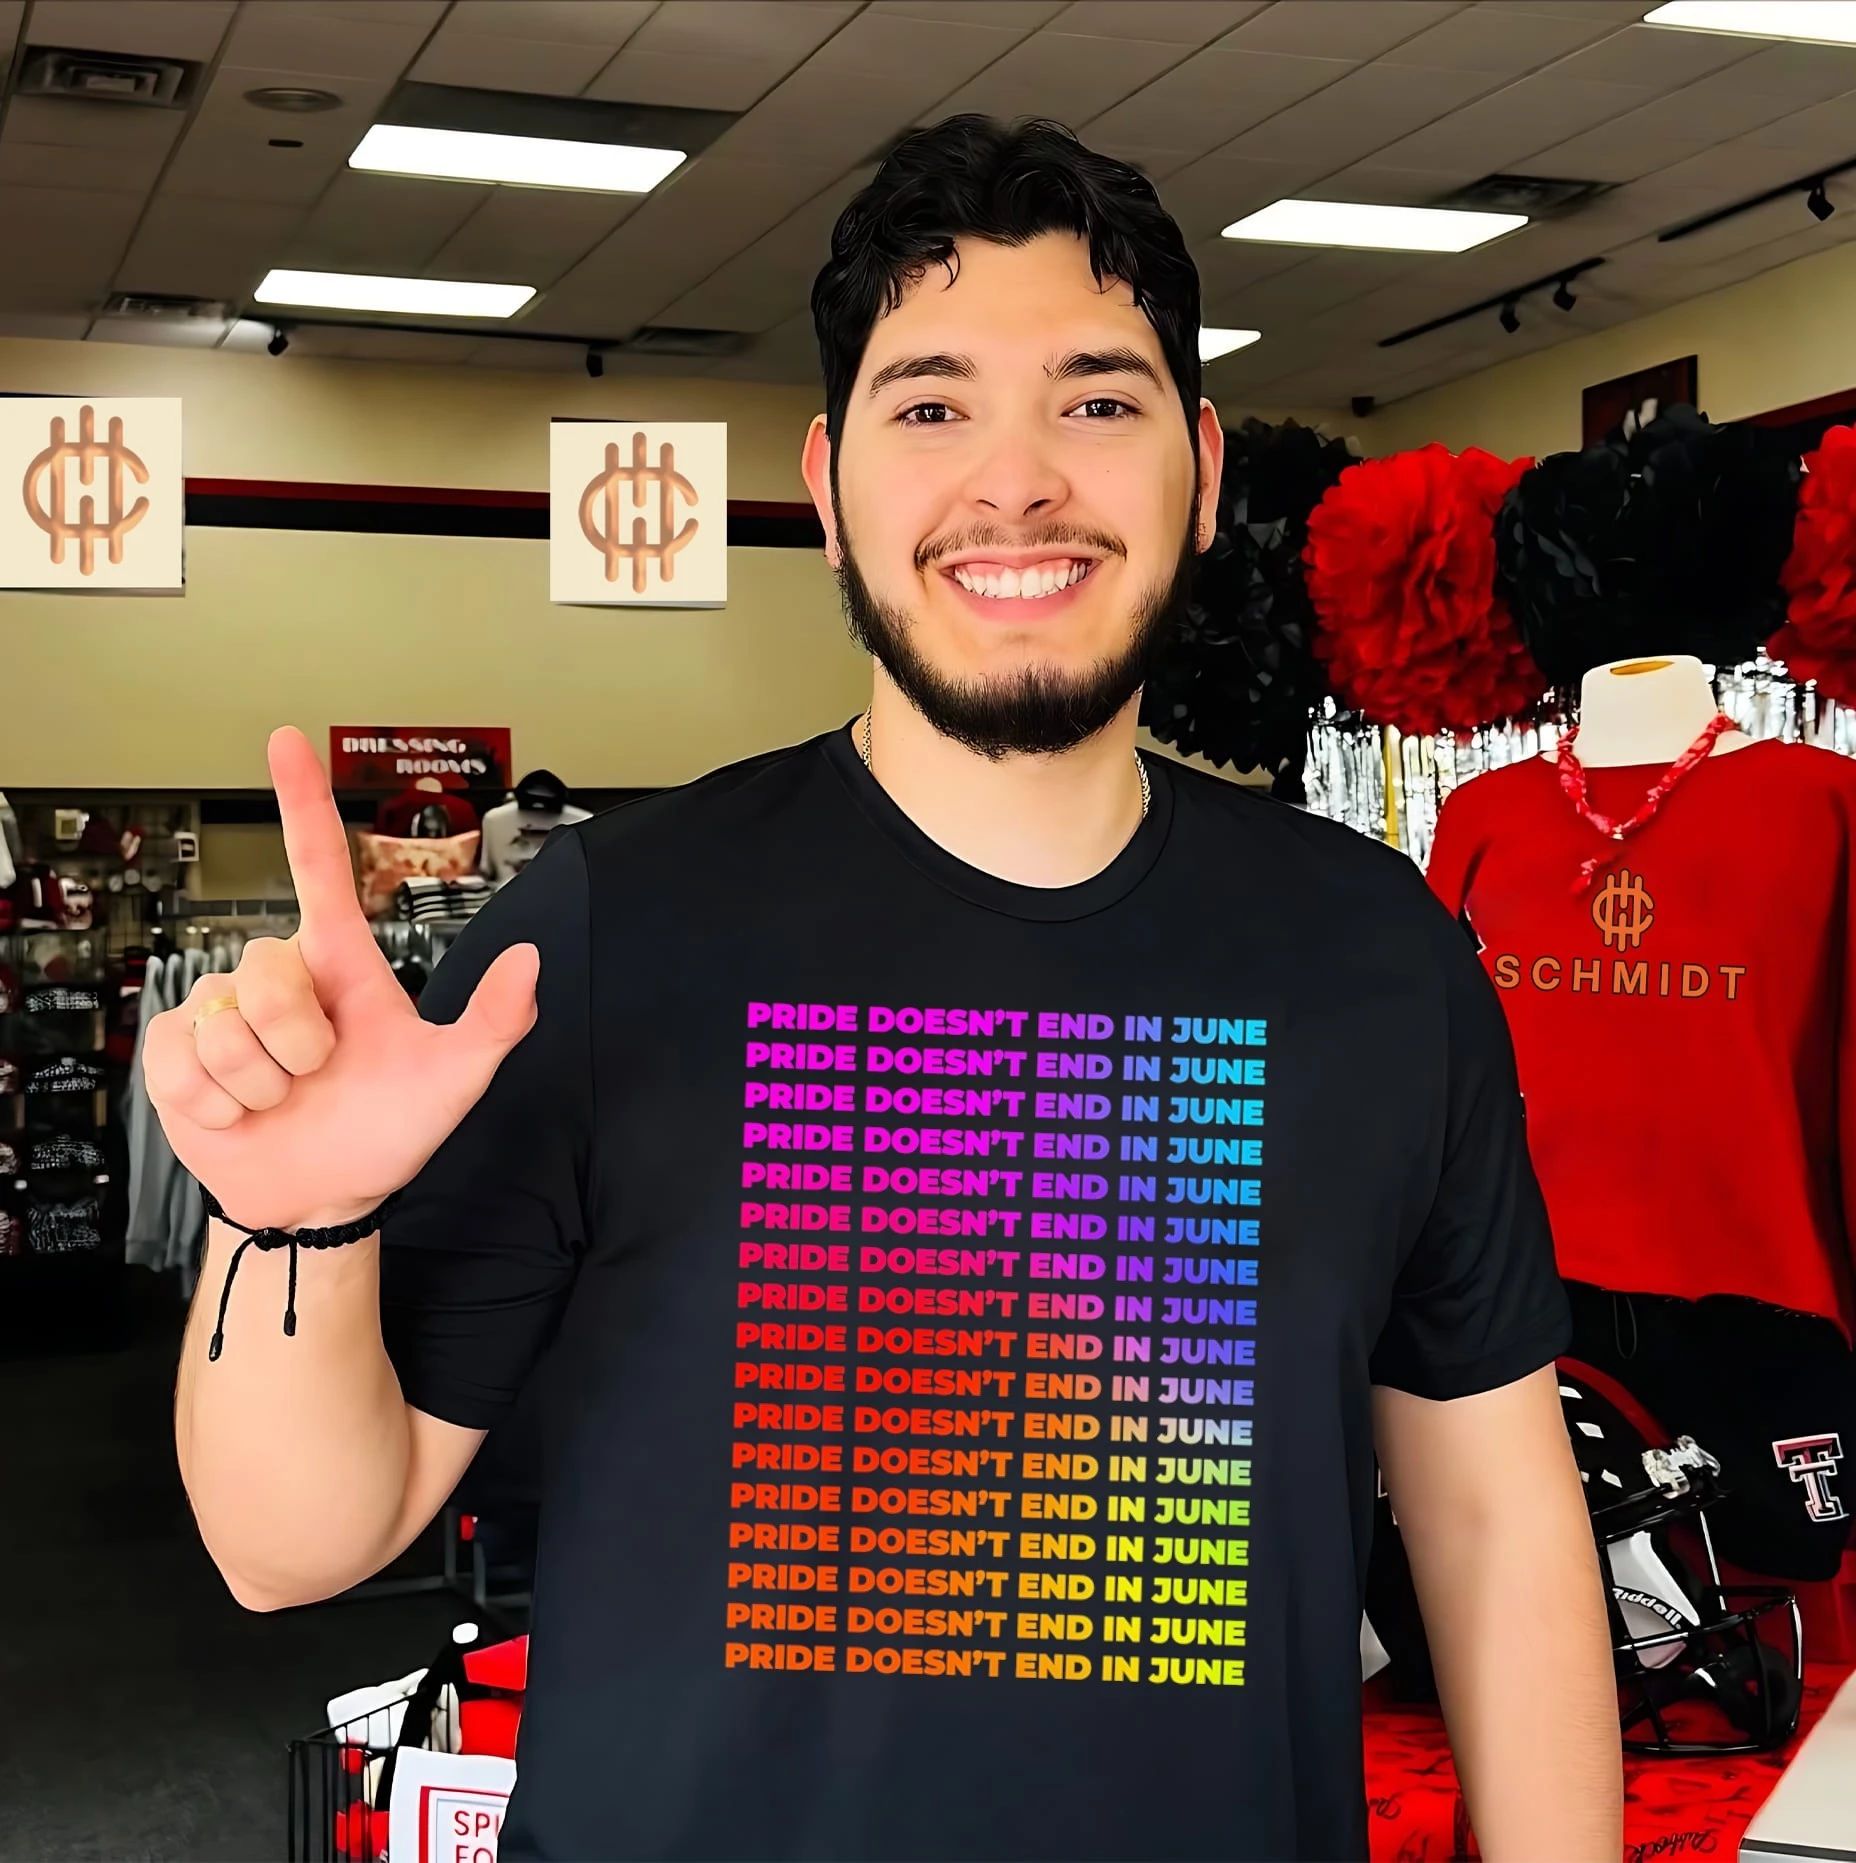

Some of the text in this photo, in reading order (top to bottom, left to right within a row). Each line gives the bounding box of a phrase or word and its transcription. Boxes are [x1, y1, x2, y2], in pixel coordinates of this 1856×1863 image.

[342, 737, 467, 754] DRESSING
[396, 758, 487, 775] ROOMS
[1494, 953, 1746, 1000] SCHMIDT
[748, 1002, 1267, 1045] PRIDE DOESN'T END IN JUNE
[746, 1042, 1265, 1085] PRIDE DOESN'T END IN JUNE
[745, 1082, 1264, 1125] PRIDE DOESN'T END IN JUNE
[744, 1123, 1262, 1165] PRIDE DOESN'T END IN JUNE
[742, 1162, 1261, 1205] PRIDE DOESN'T END IN JUNE
[741, 1202, 1260, 1245] PRIDE DOESN'T END IN JUNE
[739, 1242, 1258, 1285] PRIDE DOESN'T END IN JUNE
[738, 1282, 1257, 1326] PRIDE DOESN'T END IN JUNE
[736, 1322, 1256, 1365] PRIDE DOESN'T END IN JUNE
[735, 1362, 1254, 1405] PRIDE DOESN'T END IN JUNE
[734, 1402, 1253, 1445] PRIDE DOESN'T END IN JUNE
[732, 1442, 1251, 1486] PRIDE DOESN'T END IN JUNE
[731, 1483, 1250, 1526] PRIDE DOESN'T END IN JUNE
[730, 1523, 1248, 1566] PRIDE DOESN'T END IN JUNE
[728, 1563, 1247, 1606] PRIDE DOESN'T END IN JUNE
[727, 1603, 1246, 1646] PRIDE DOESN'T END IN JUNE
[726, 1643, 1244, 1685] PRIDE DOESN'T END IN JUNE
